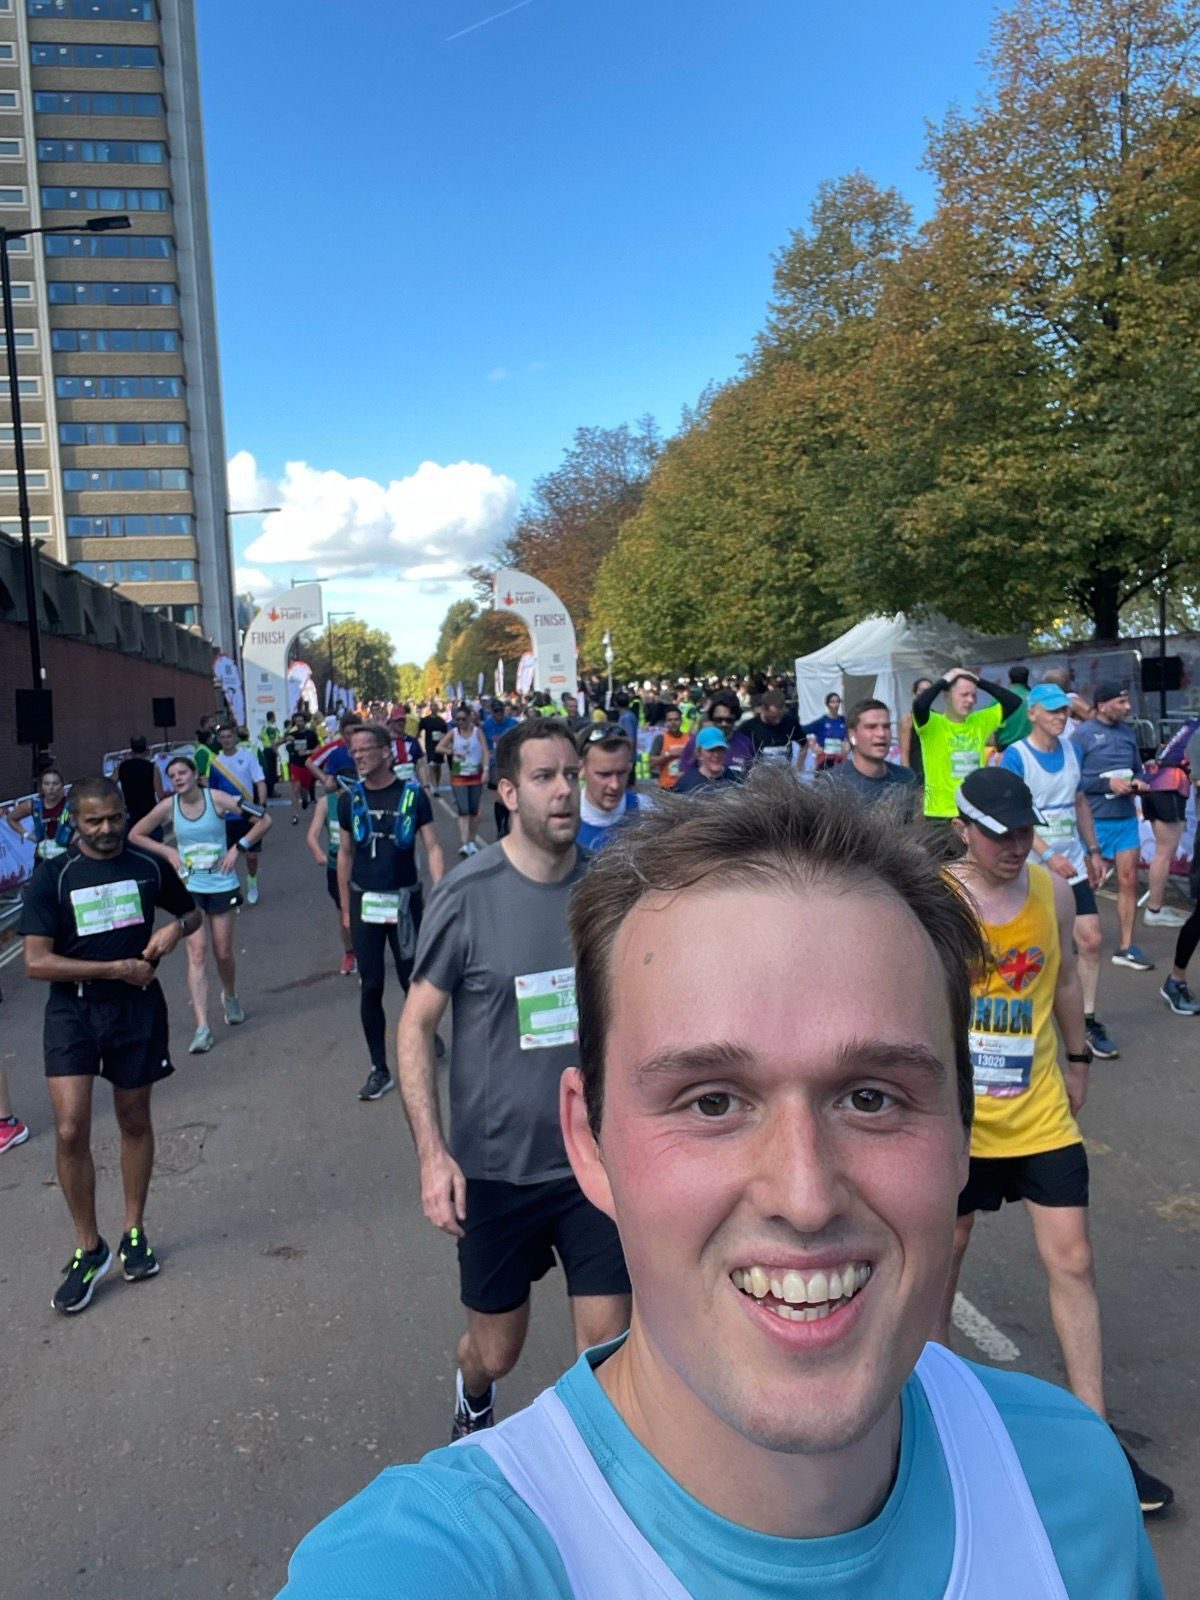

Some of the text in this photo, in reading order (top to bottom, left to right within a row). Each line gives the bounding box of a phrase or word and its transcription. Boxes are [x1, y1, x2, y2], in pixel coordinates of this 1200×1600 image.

[534, 613, 566, 627] FINISH
[251, 631, 285, 645] FINISH
[977, 1055, 1005, 1067] 13020
